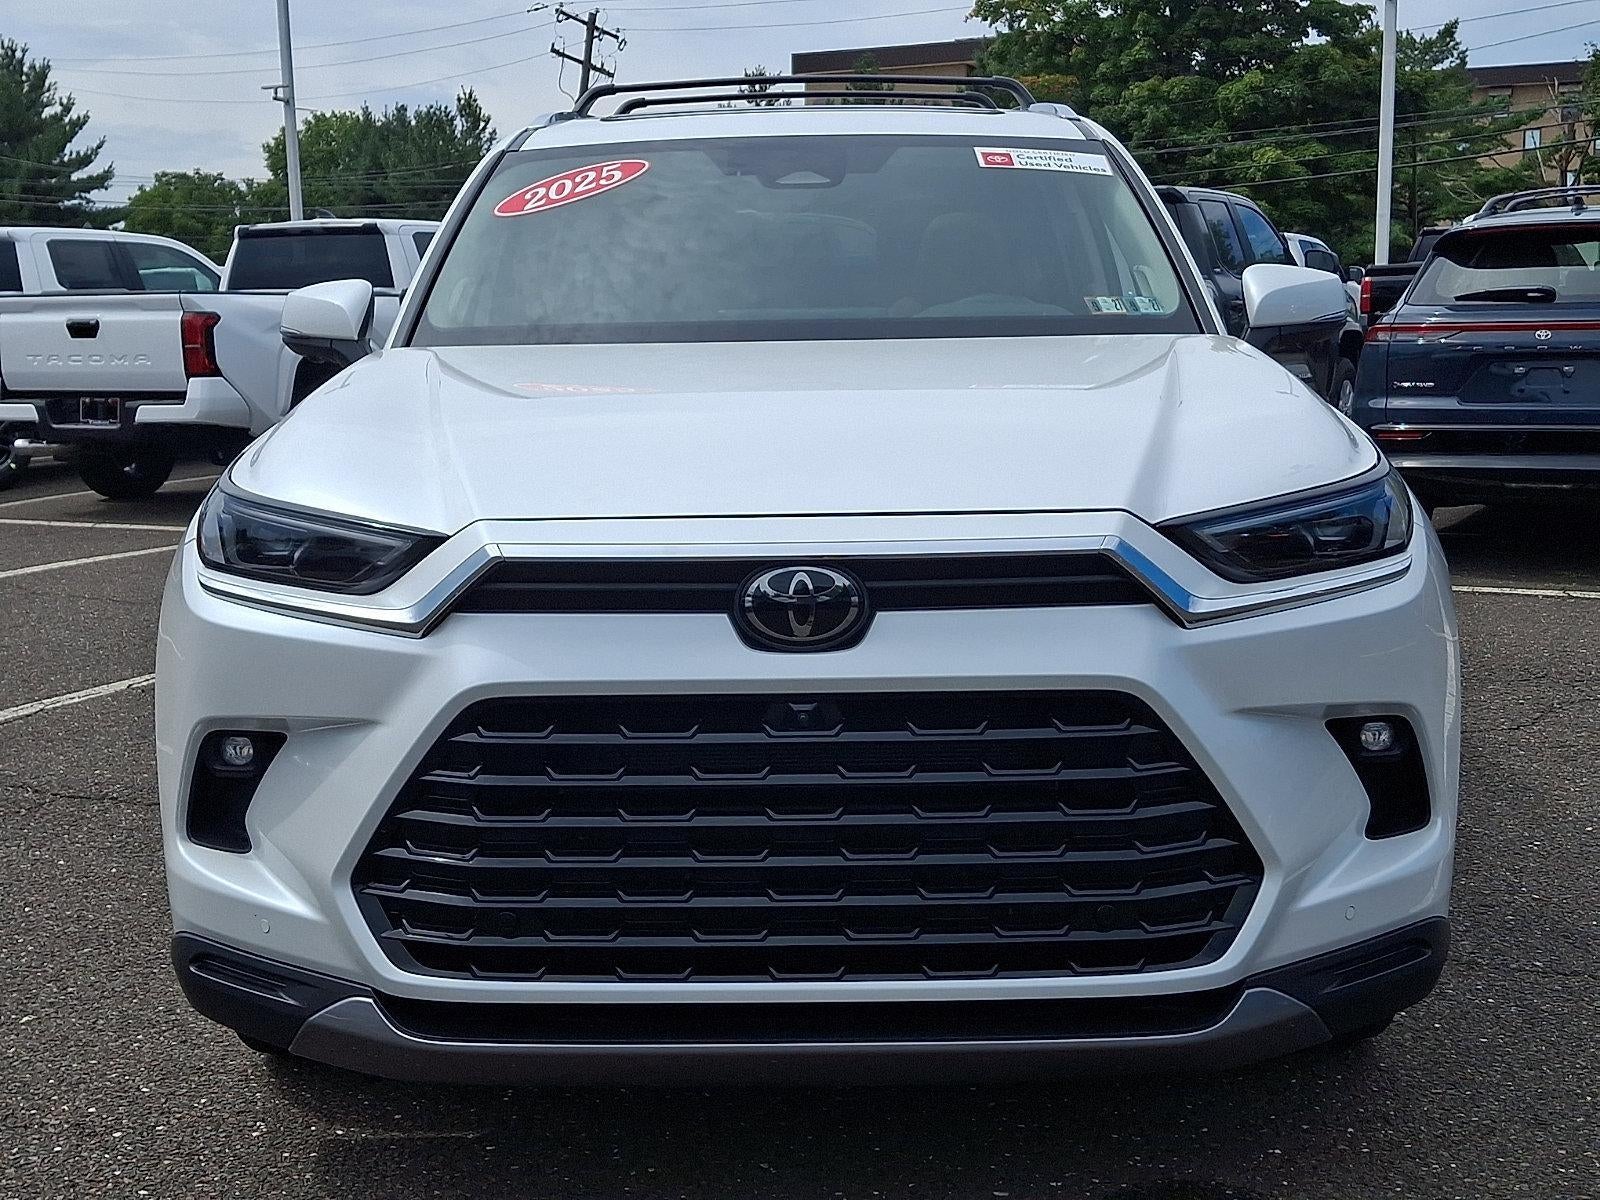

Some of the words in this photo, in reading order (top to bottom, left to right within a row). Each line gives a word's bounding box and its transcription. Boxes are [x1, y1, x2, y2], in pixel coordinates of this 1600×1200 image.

[1016, 153, 1073, 163] Certified
[1018, 160, 1052, 168] Used
[1053, 162, 1107, 173] Vehicles
[522, 163, 623, 211] 2025
[25, 353, 152, 366] TACOMA
